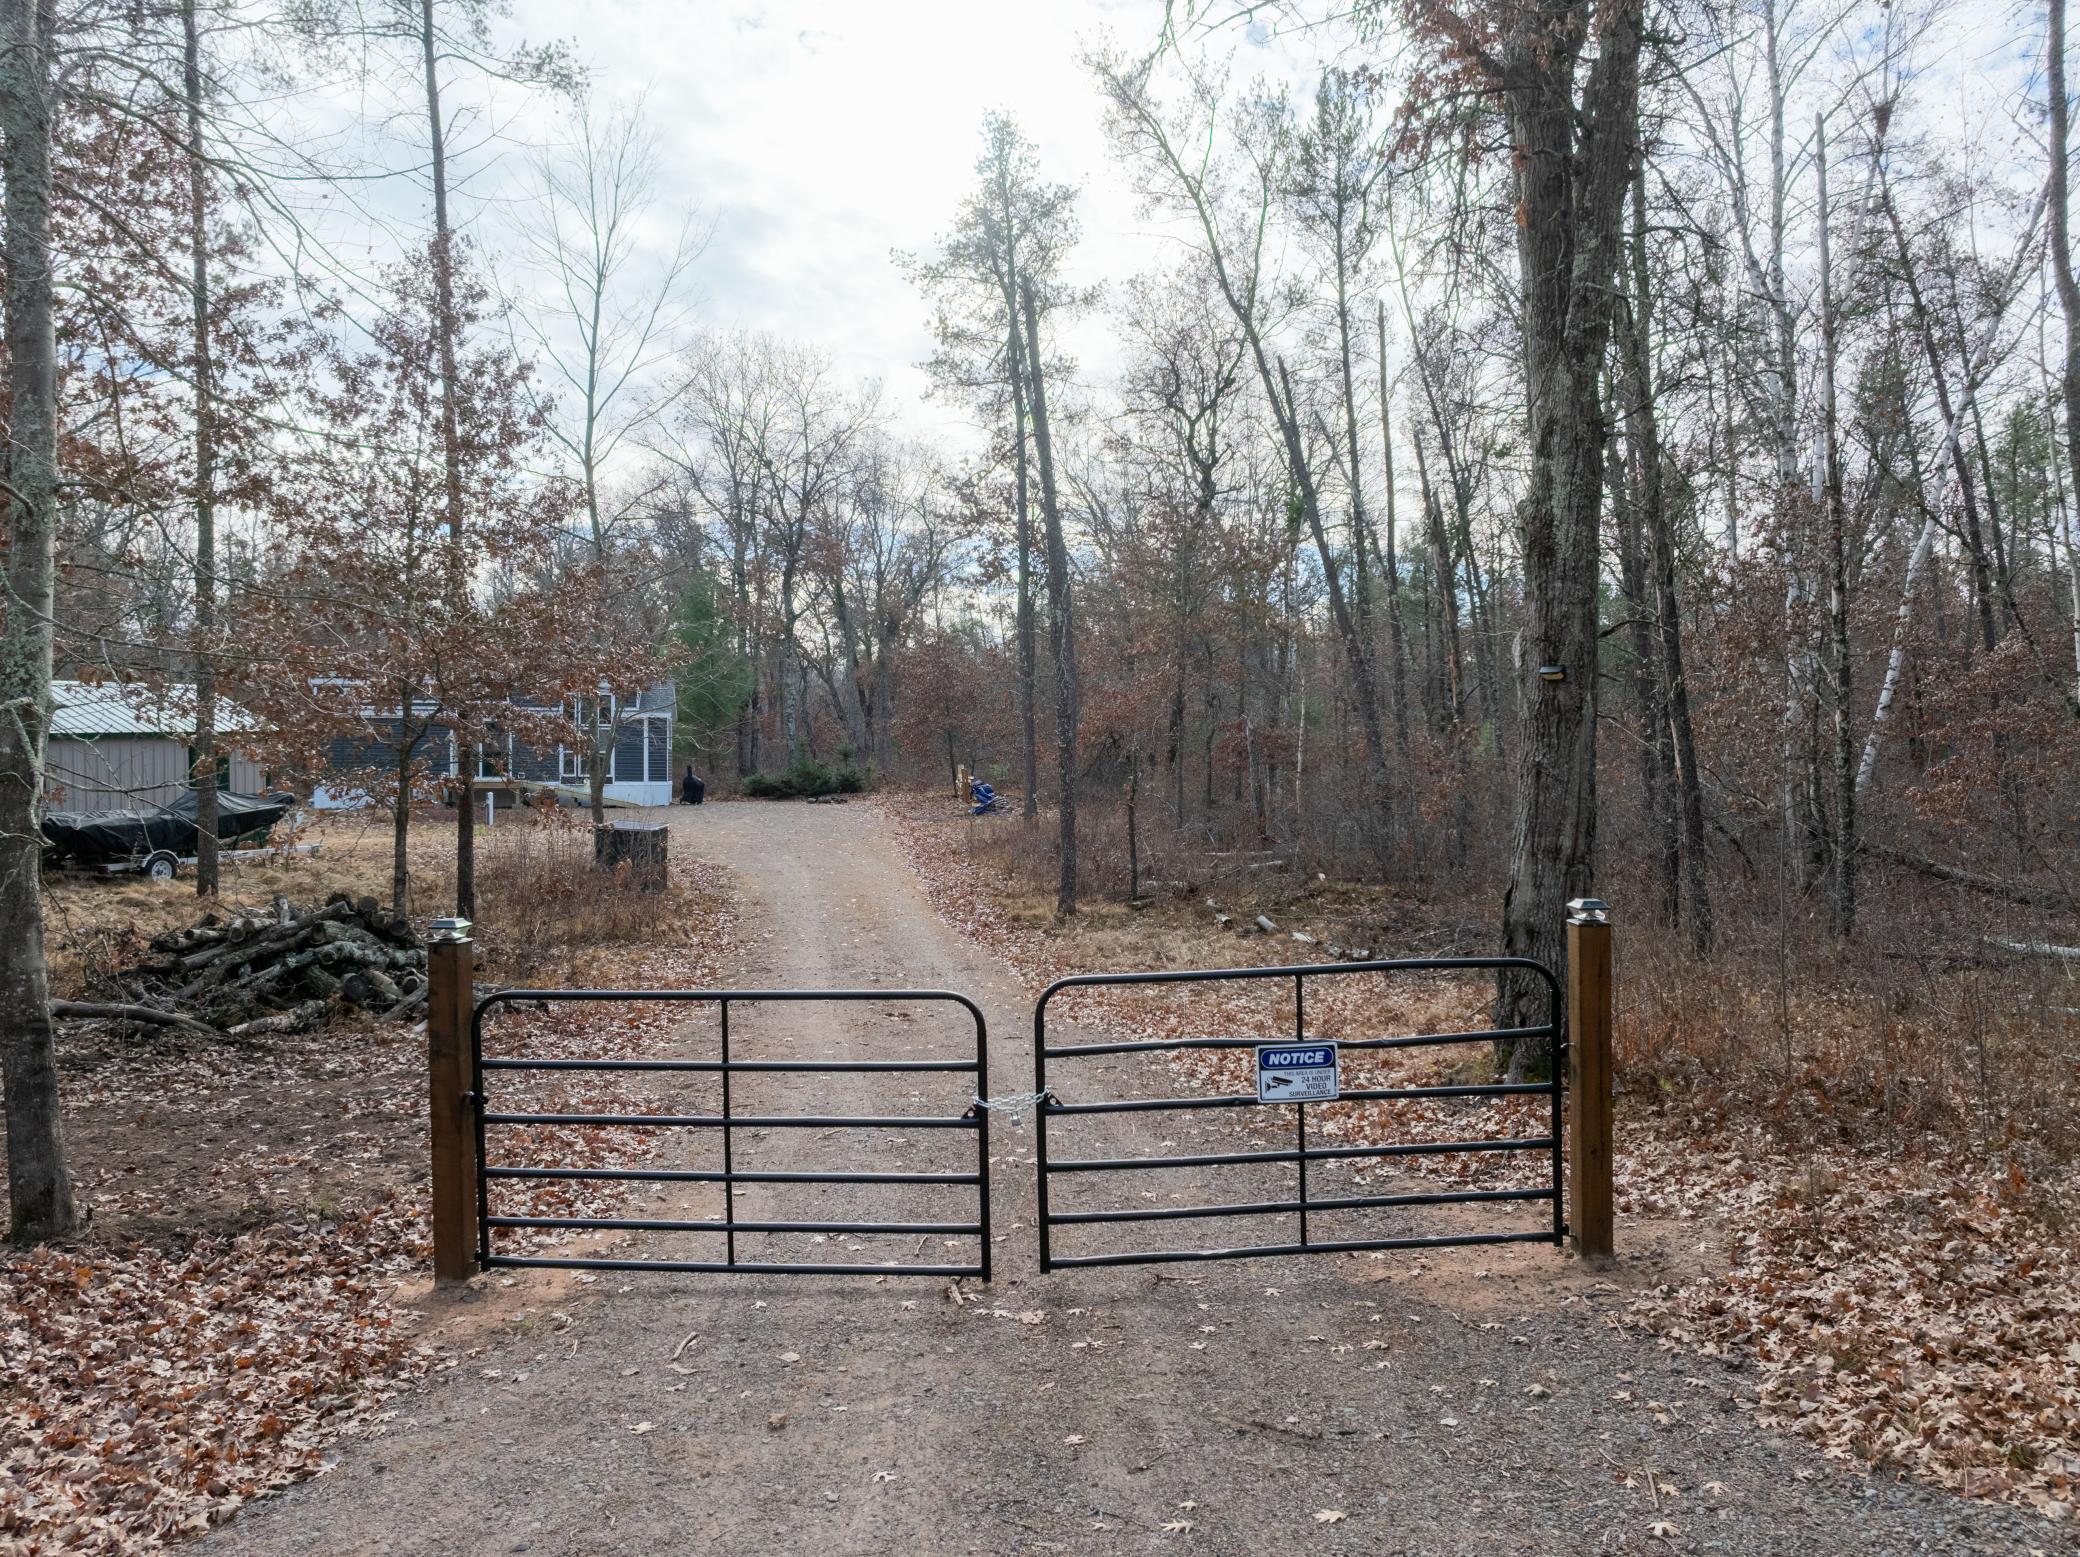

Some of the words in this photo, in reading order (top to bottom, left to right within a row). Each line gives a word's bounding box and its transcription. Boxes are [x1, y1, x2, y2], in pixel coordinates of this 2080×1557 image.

[1268, 1051, 1325, 1065] NOTICE
[1312, 1075, 1331, 1083] HOUR
[1289, 1089, 1331, 1097] SURVEILLANCE
